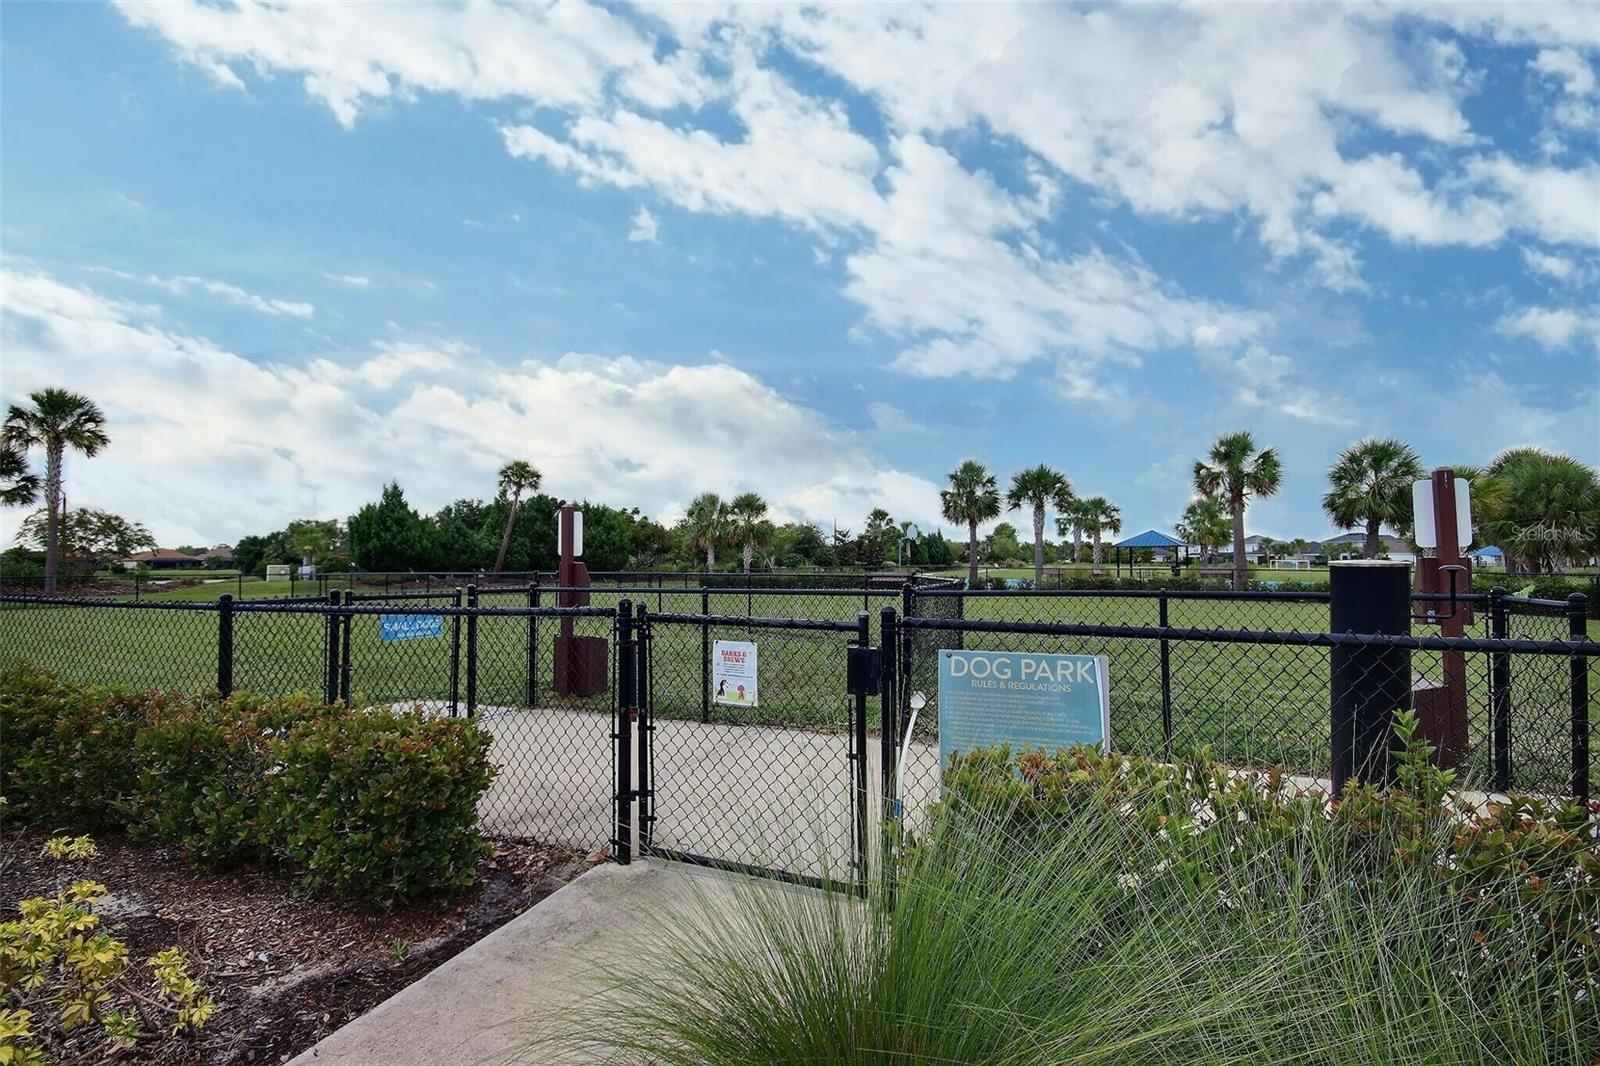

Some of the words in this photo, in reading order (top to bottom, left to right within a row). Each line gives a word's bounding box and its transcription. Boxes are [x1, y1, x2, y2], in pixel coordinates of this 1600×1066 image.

[950, 656, 1012, 680] DOG
[1020, 658, 1095, 684] PARK
[971, 680, 998, 689] RULES
[999, 681, 1006, 689] &
[1009, 681, 1072, 693] REGULATIONS
